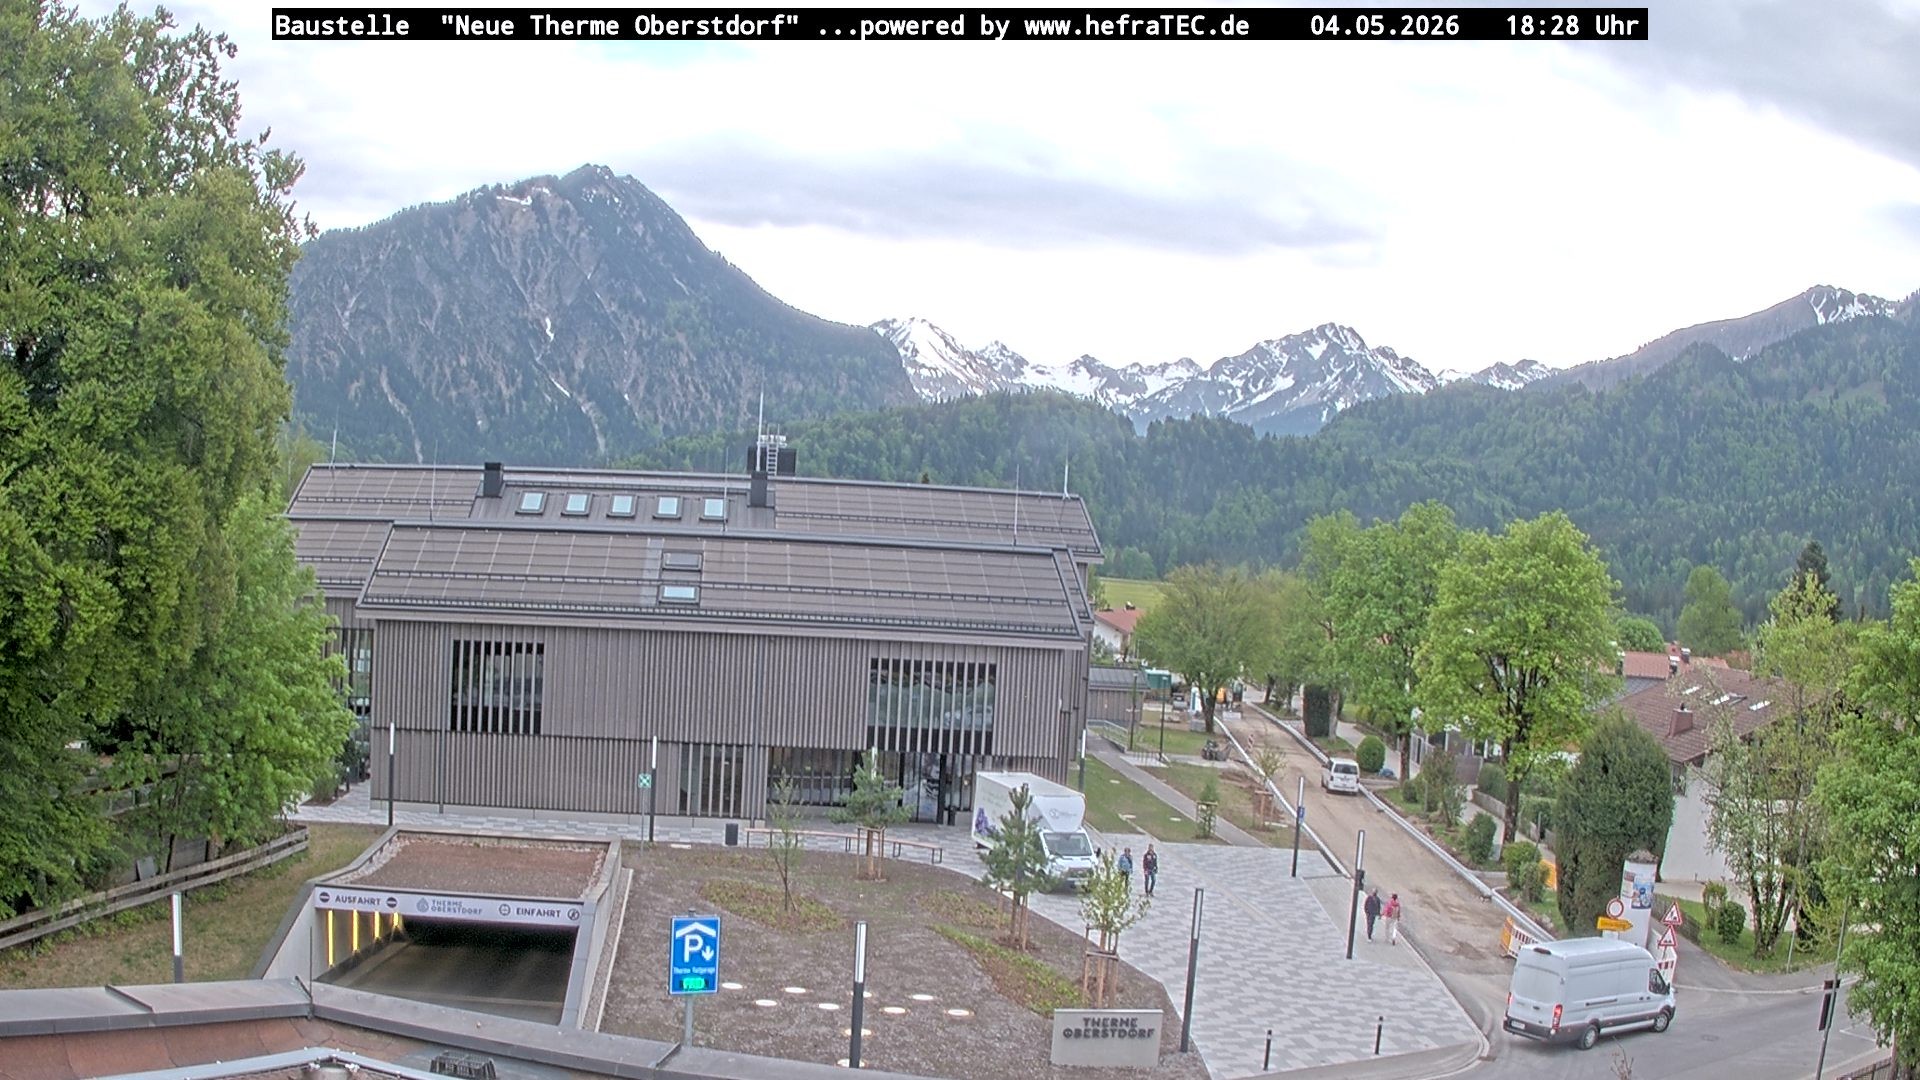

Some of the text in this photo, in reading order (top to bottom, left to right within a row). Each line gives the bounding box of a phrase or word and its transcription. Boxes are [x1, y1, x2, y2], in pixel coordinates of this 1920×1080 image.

[335, 895, 381, 906] AUSFAHRT
[431, 905, 482, 915] OBERSTDORF
[516, 907, 561, 918] EINFAHRT
[683, 934, 704, 963] P
[1083, 1017, 1138, 1028] THERME
[1063, 1028, 1155, 1039] OBERSTDORF
